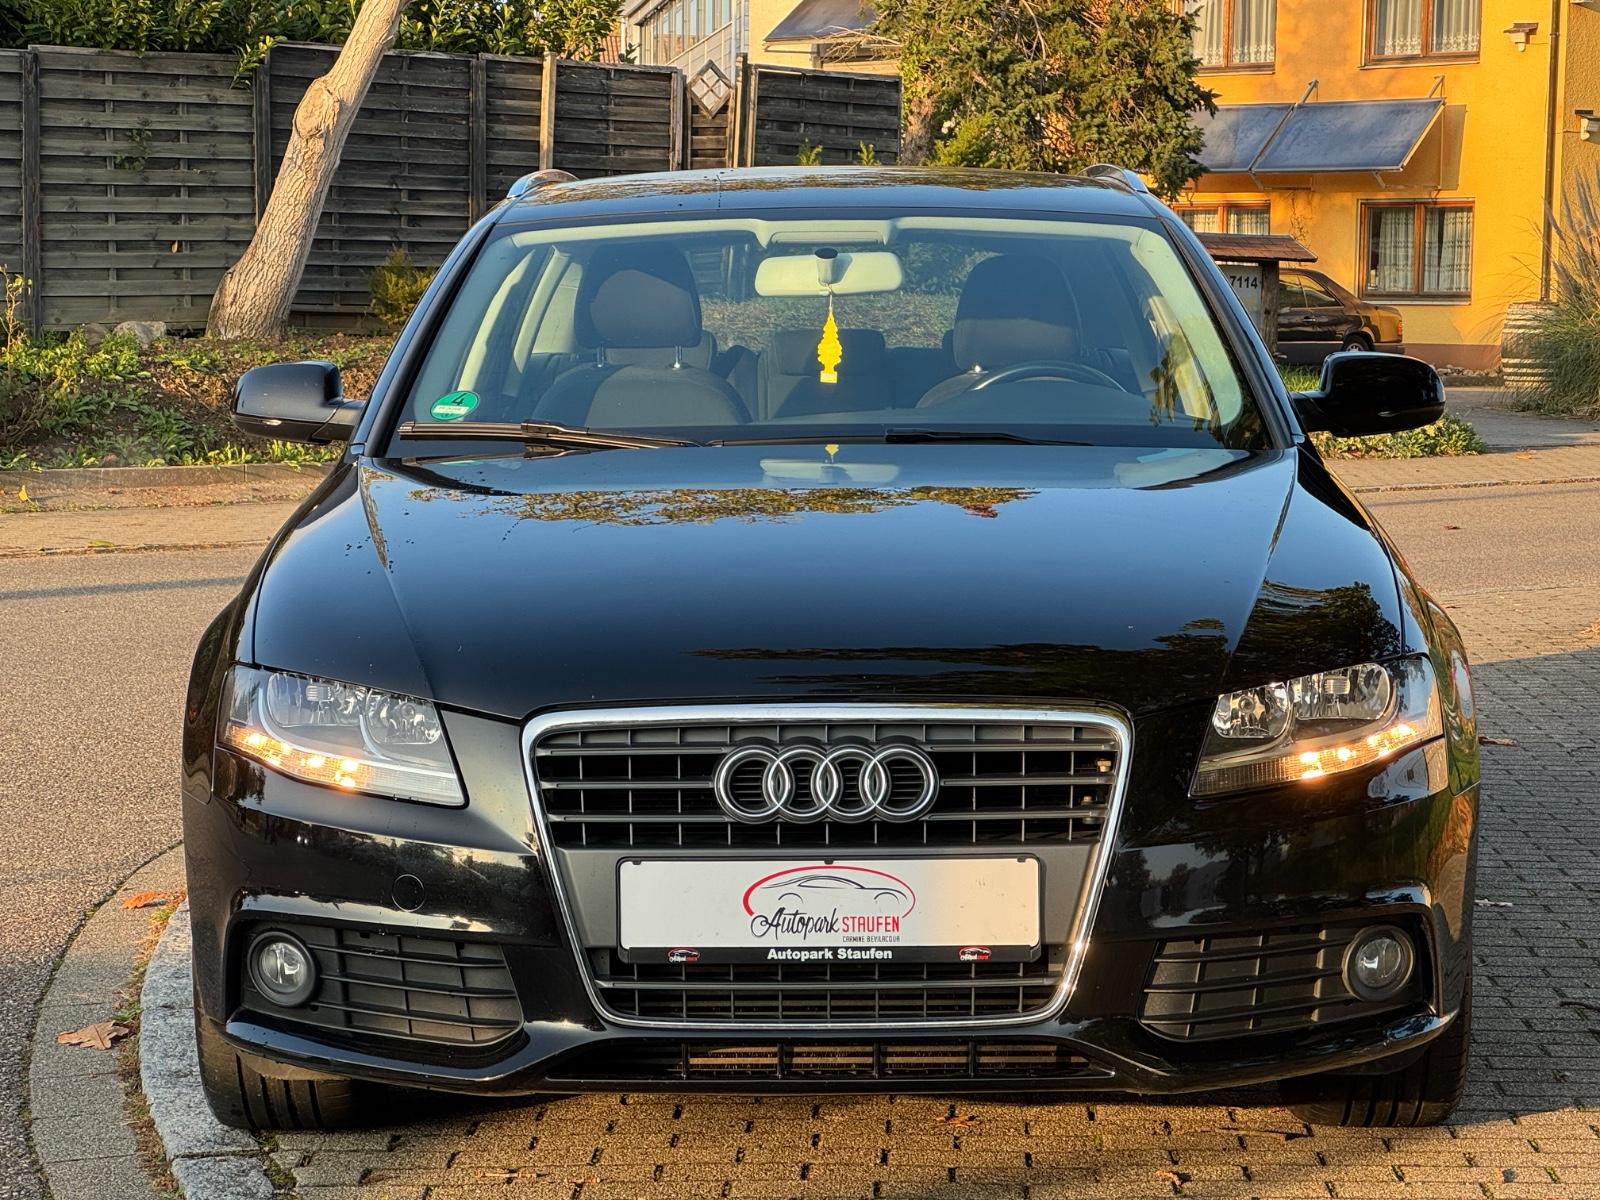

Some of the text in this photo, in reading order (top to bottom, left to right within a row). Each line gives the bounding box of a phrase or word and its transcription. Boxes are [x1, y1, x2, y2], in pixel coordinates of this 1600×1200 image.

[1230, 275, 1258, 289] 7114
[451, 392, 468, 406] 4
[750, 906, 900, 941] Autopark STAUFEN
[767, 948, 893, 961] Autopark Staufen
